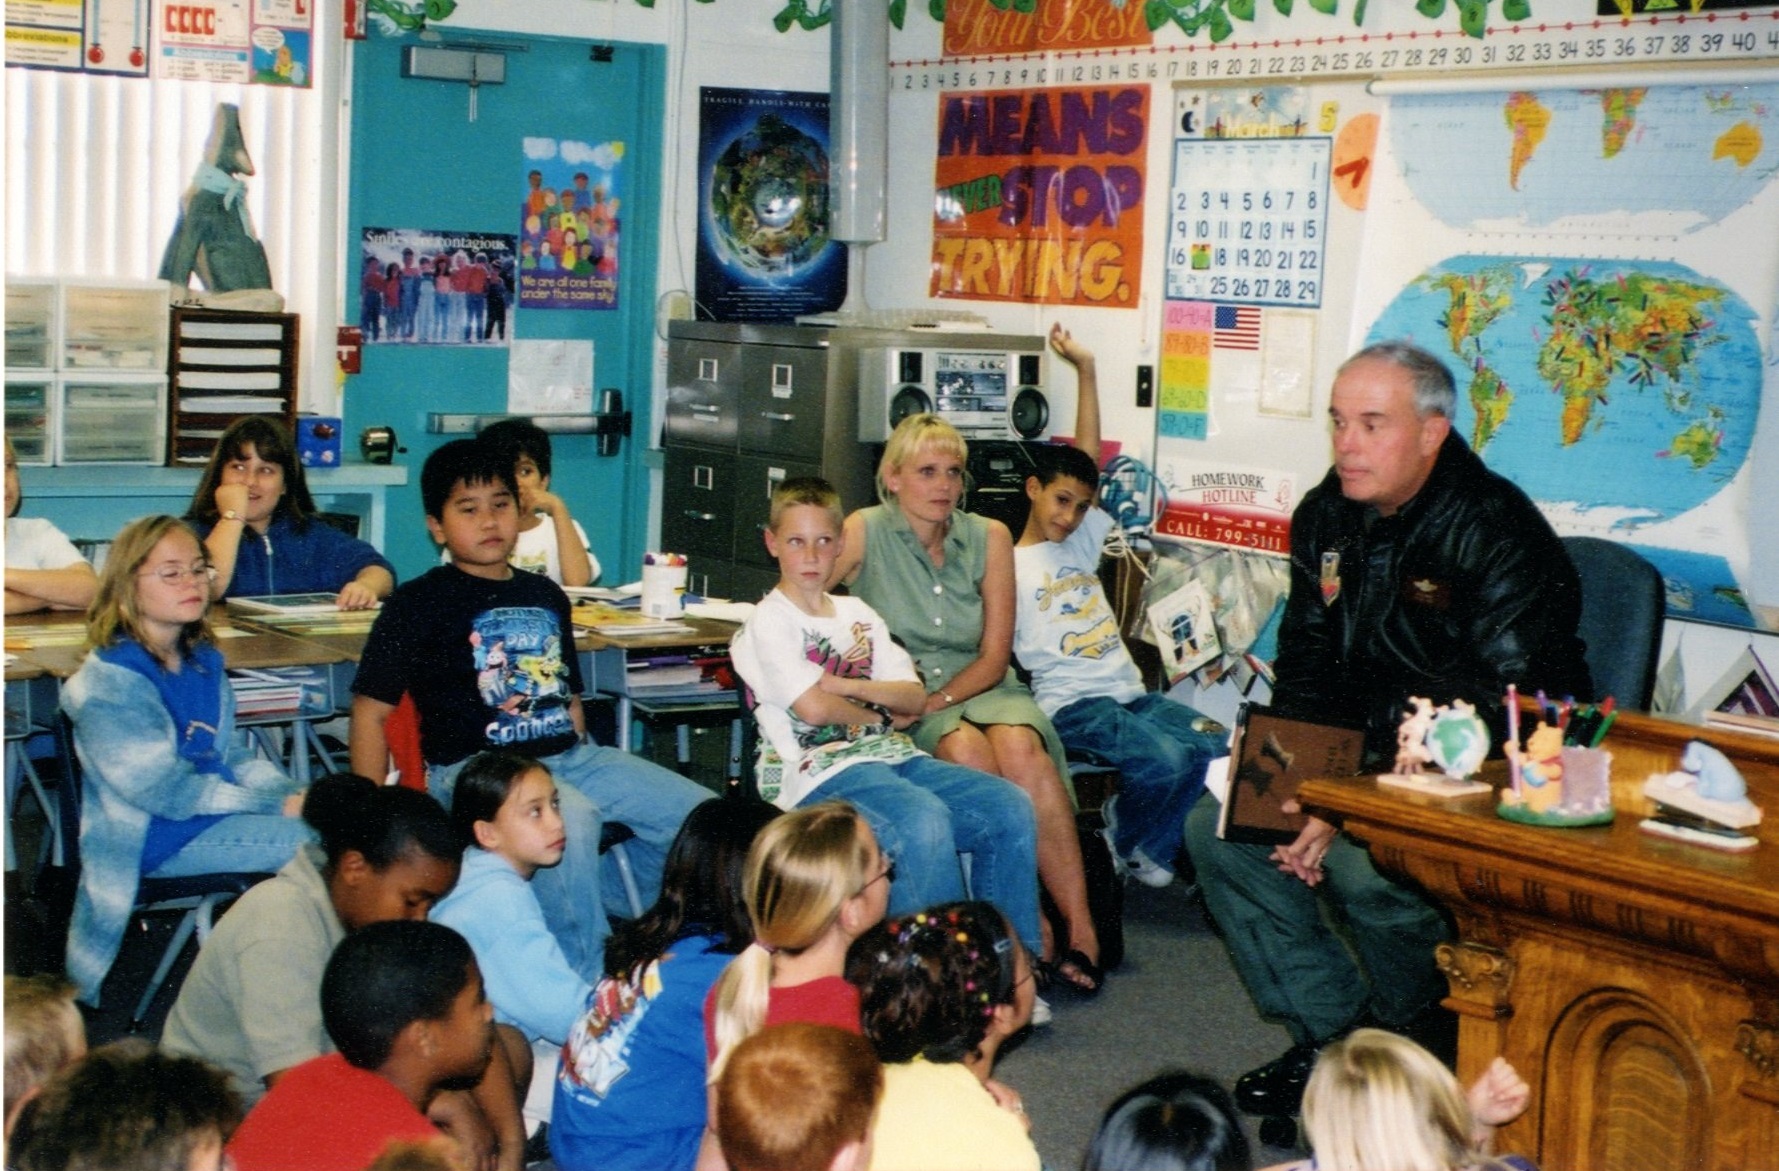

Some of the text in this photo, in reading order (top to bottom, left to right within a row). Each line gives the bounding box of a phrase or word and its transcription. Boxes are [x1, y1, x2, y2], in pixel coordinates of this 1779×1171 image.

[1036, 0, 1148, 44] Best
[904, 74, 912, 90] 2
[922, 74, 928, 88] 3
[937, 73, 945, 88] 4
[952, 72, 960, 86] 5
[969, 72, 976, 86] 6
[988, 71, 995, 86] 7
[1004, 70, 1011, 85] 8
[1020, 69, 1028, 84] 9
[1036, 68, 1046, 84] 10
[1055, 68, 1064, 82] 11
[1072, 66, 1083, 81] 12
[1091, 65, 1101, 80] 13
[1109, 64, 1119, 79] 14
[1128, 62, 1139, 78] 15
[1147, 62, 1158, 78] 16
[1166, 61, 1178, 77] 17
[1186, 60, 1198, 76] 18
[1206, 59, 1219, 75] 19
[1226, 58, 1242, 75] 20
[1250, 58, 1262, 75] 21
[1268, 57, 1284, 74] 22
[1290, 56, 1305, 72] 23
[1311, 54, 1327, 72] 24
[1332, 54, 1349, 70] 25
[1355, 52, 1372, 69] 26
[1381, 50, 1399, 68] 27
[1404, 49, 1422, 66] 28
[1428, 48, 1448, 66] 29
[1454, 47, 1472, 64] 30
[1482, 46, 1496, 63] 31
[1506, 44, 1525, 62] 32
[1532, 43, 1551, 60] 33
[1558, 40, 1578, 59] 34
[1585, 39, 1606, 57] 35
[1614, 37, 1635, 56] 36
[1644, 36, 1665, 54] 37
[1671, 35, 1691, 53] 38
[1701, 33, 1724, 52] 39
[1732, 32, 1756, 51] 40
[1768, 30, 1778, 50] 4
[938, 88, 1144, 156] MEANS
[1312, 162, 1317, 180] 1
[936, 164, 1143, 228] EVER STOP
[1177, 190, 1317, 211] 2 3 4 5 6 7 8
[1177, 220, 1316, 240] 9 10 11 12 13 14 15
[934, 236, 1130, 302] TRYING.
[1171, 248, 1317, 269] 16 18 19 20 21 22
[521, 275, 616, 292] We are all one family
[521, 288, 551, 299] under
[552, 288, 568, 299] the
[570, 291, 596, 300] same
[1210, 276, 1228, 295] 25
[1232, 278, 1249, 296] 26
[1254, 279, 1269, 298] 27
[1275, 279, 1291, 298] 28
[1298, 281, 1316, 299] 29
[1192, 472, 1265, 489] HOMEWORK
[1202, 489, 1258, 504] HOTLINE
[1166, 520, 1208, 538] CALL:
[1216, 528, 1281, 550] 799-5111
[506, 632, 540, 648] DAY
